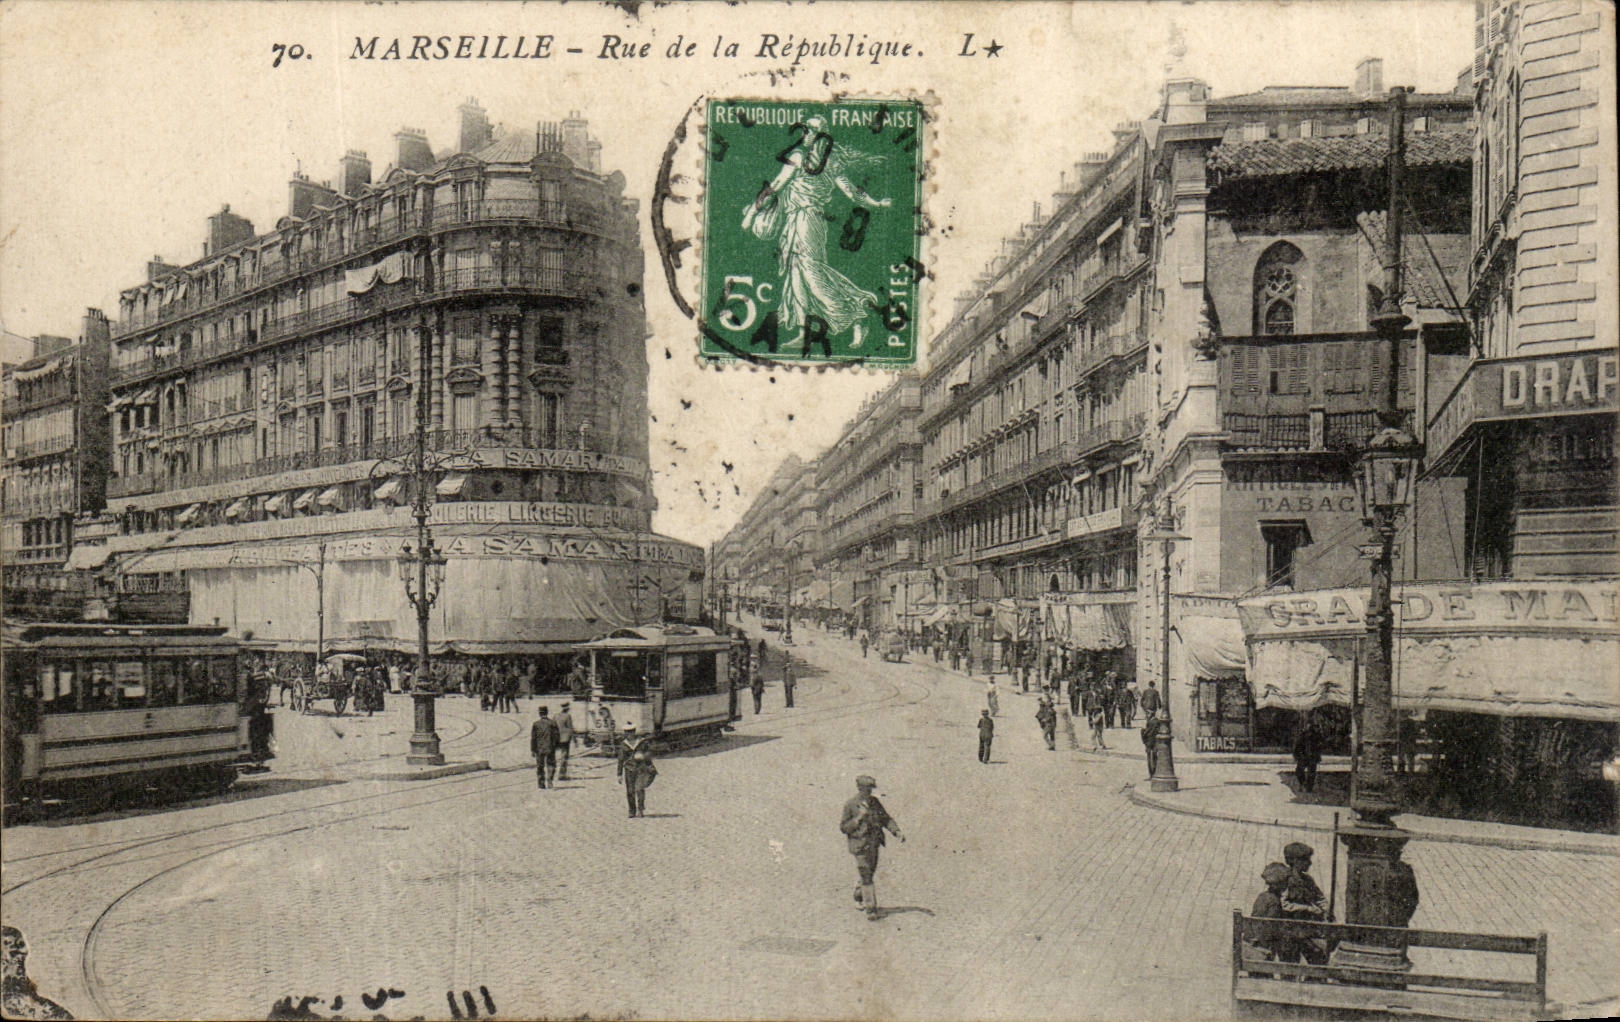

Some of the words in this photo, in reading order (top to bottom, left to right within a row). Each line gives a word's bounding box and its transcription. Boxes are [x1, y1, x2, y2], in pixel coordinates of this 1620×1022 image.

[715, 105, 805, 128] REPUBLIQUE
[831, 109, 914, 128] FRANAISE
[887, 263, 909, 347] POSTES
[1267, 589, 1476, 628] GRADE
[1197, 736, 1236, 750] TABACS
